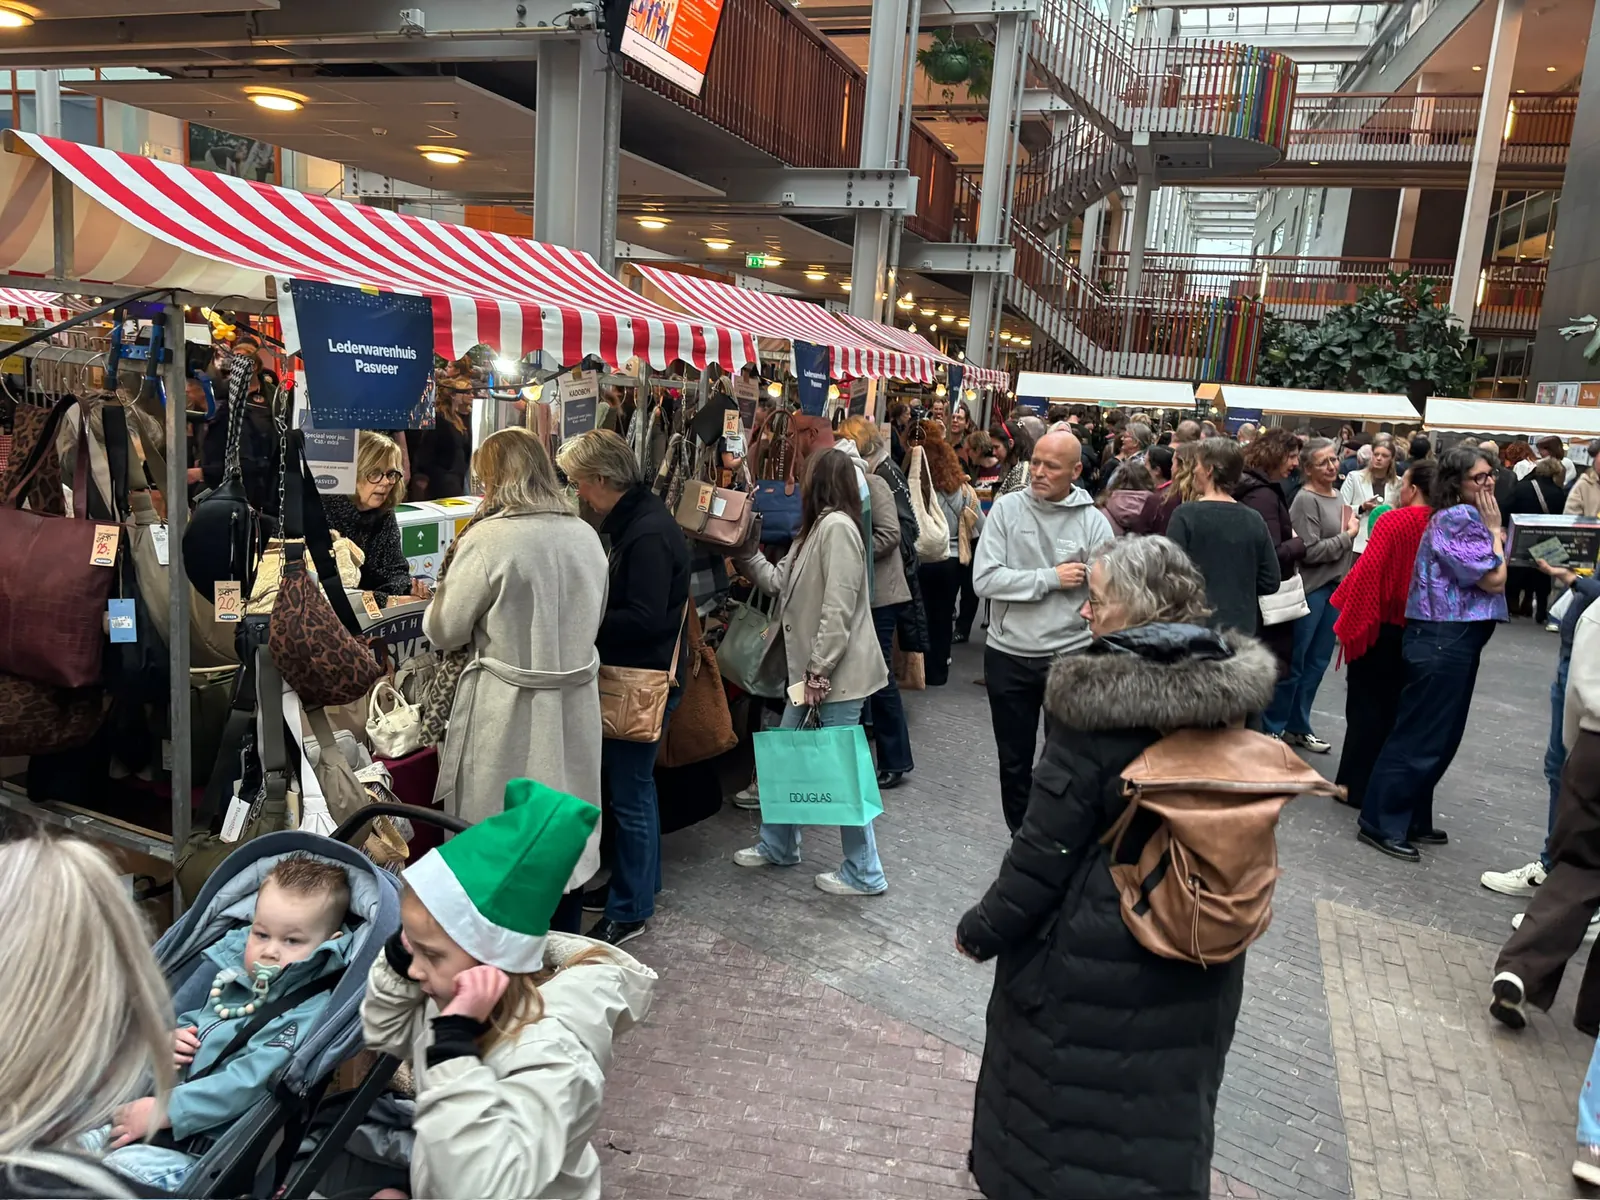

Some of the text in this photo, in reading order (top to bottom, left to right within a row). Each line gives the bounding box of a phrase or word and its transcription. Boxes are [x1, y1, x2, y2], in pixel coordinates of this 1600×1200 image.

[327, 338, 417, 360] Lederwarenhuis
[354, 358, 399, 375] Pasveer
[569, 387, 591, 398] KADOBON
[314, 478, 338, 486] PASVEER
[789, 791, 833, 803] DOUGLAS
